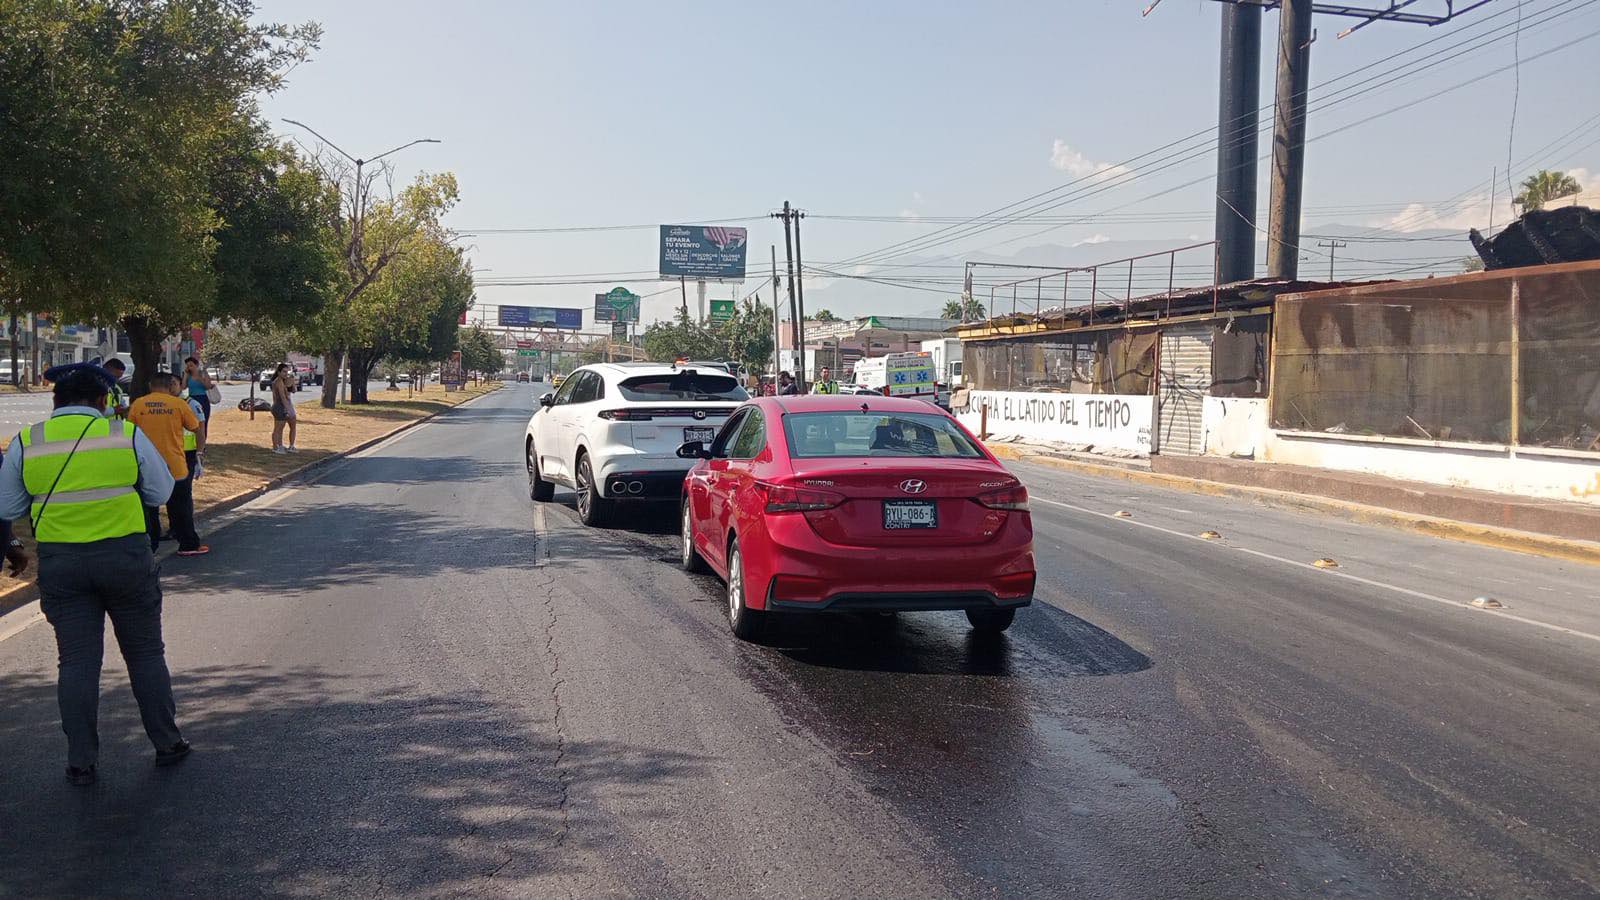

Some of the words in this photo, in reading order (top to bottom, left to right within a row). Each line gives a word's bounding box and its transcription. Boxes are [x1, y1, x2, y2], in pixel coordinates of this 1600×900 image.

[1004, 397, 1016, 421] EL
[1019, 398, 1056, 424] LATIDO
[1060, 398, 1079, 426] DEL
[1085, 399, 1131, 431] TIEMPO
[803, 479, 834, 487] HYUNDAI
